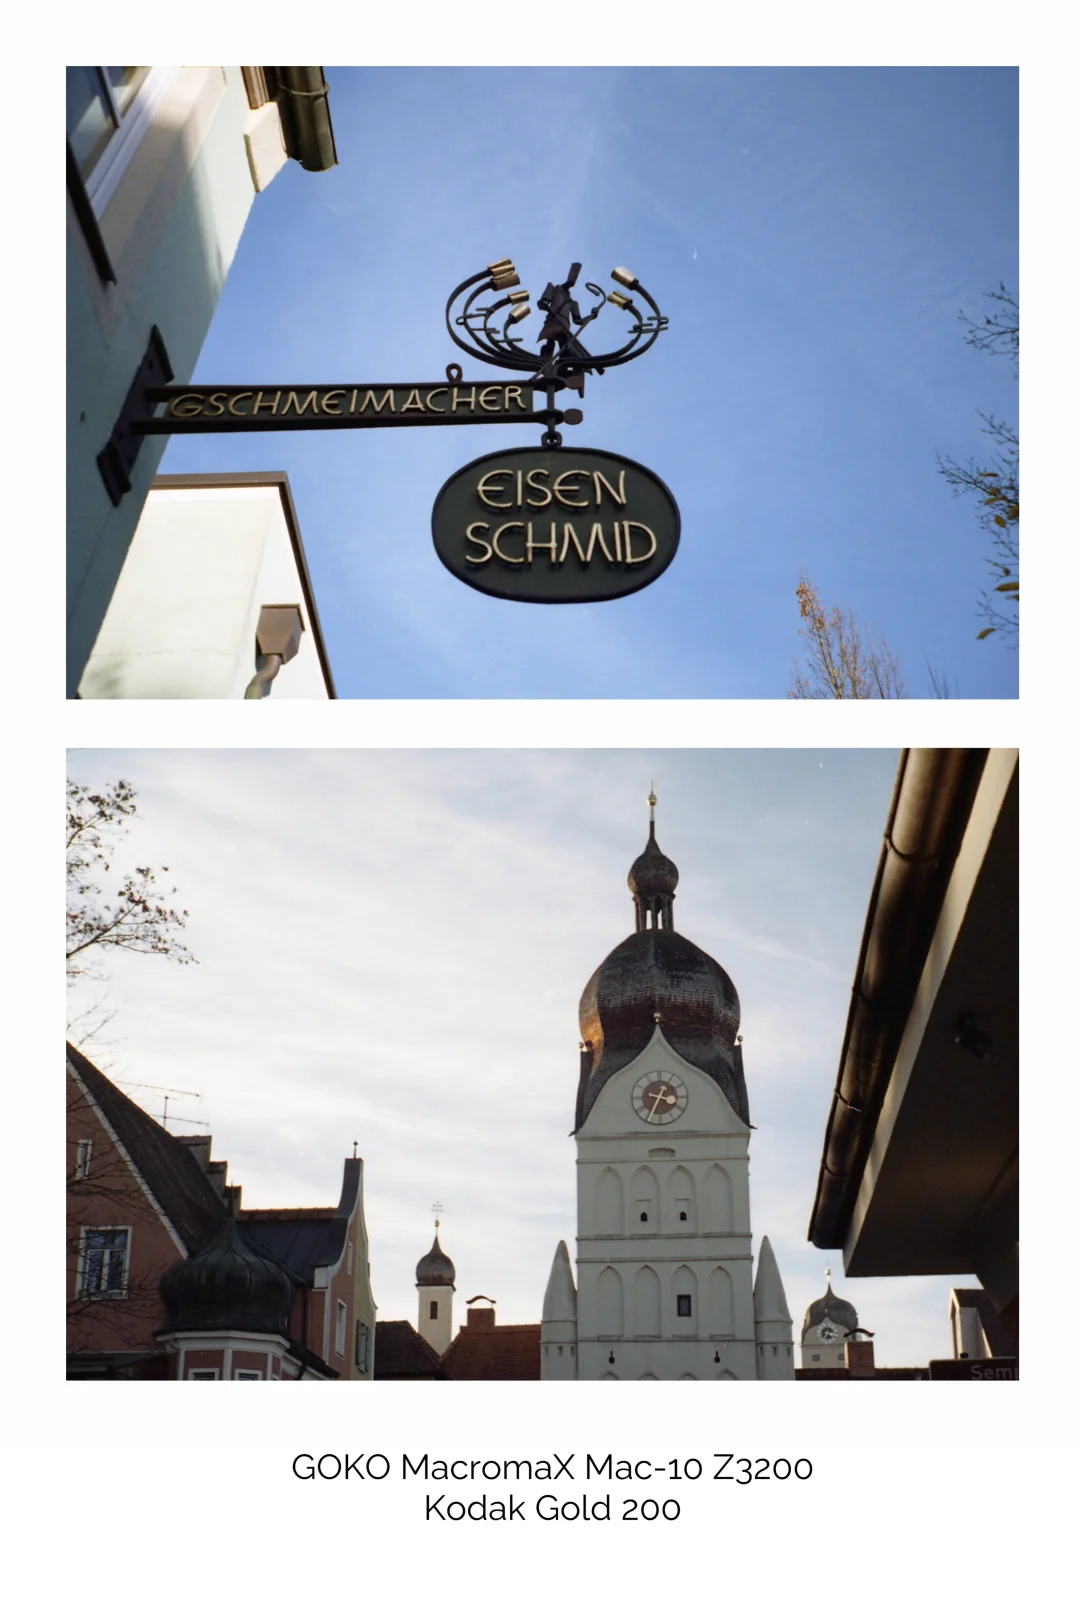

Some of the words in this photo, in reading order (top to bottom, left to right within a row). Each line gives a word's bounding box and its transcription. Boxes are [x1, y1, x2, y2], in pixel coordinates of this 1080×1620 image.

[170, 386, 527, 417] GSCHMEIMACHER
[477, 469, 627, 508] EISEN
[465, 520, 657, 564] SCHMID
